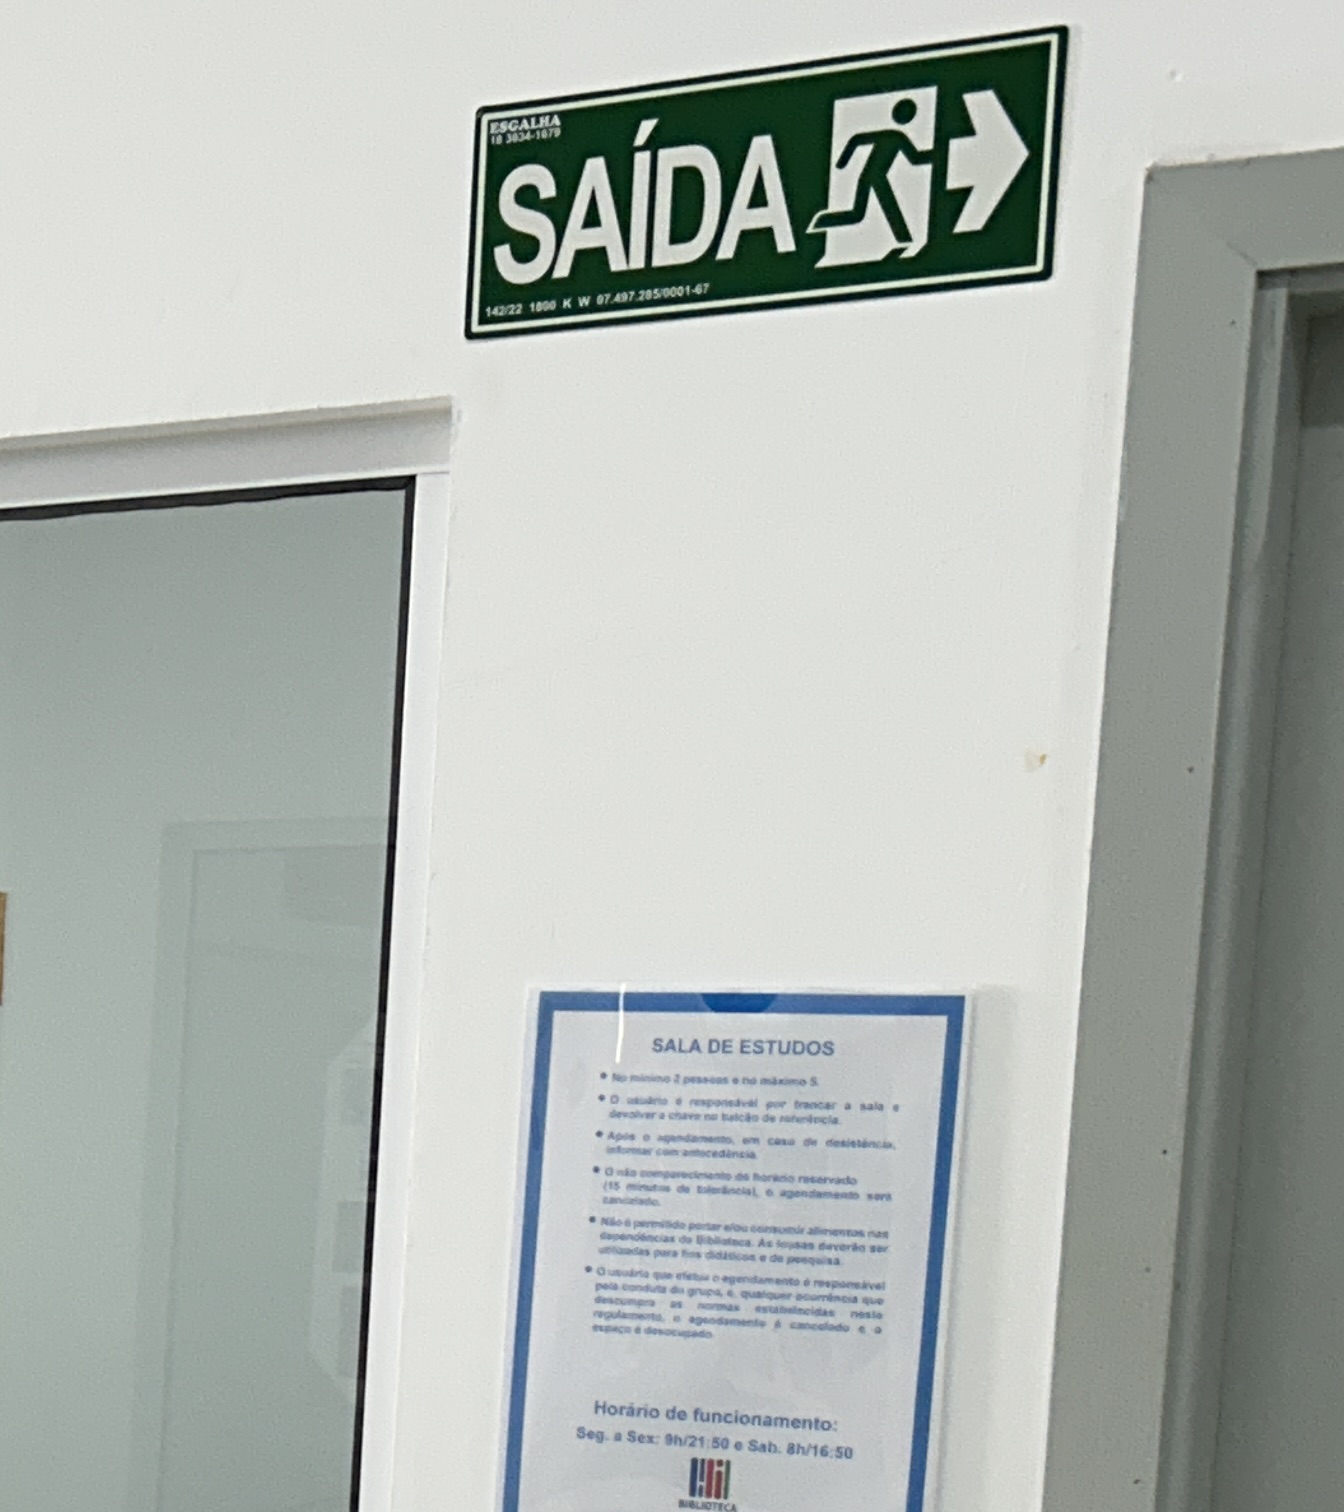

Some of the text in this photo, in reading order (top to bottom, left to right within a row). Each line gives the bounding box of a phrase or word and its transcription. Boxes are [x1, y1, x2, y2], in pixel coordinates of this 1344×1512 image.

[493, 119, 797, 285] SAÍDA
[563, 297, 572, 309] K
[578, 295, 591, 308] W
[652, 1038, 835, 1056] SALA DE ESTUDOS
[594, 1400, 838, 1432] Horário de funcionamento:
[614, 1432, 622, 1442] a
[734, 1441, 743, 1451] e
